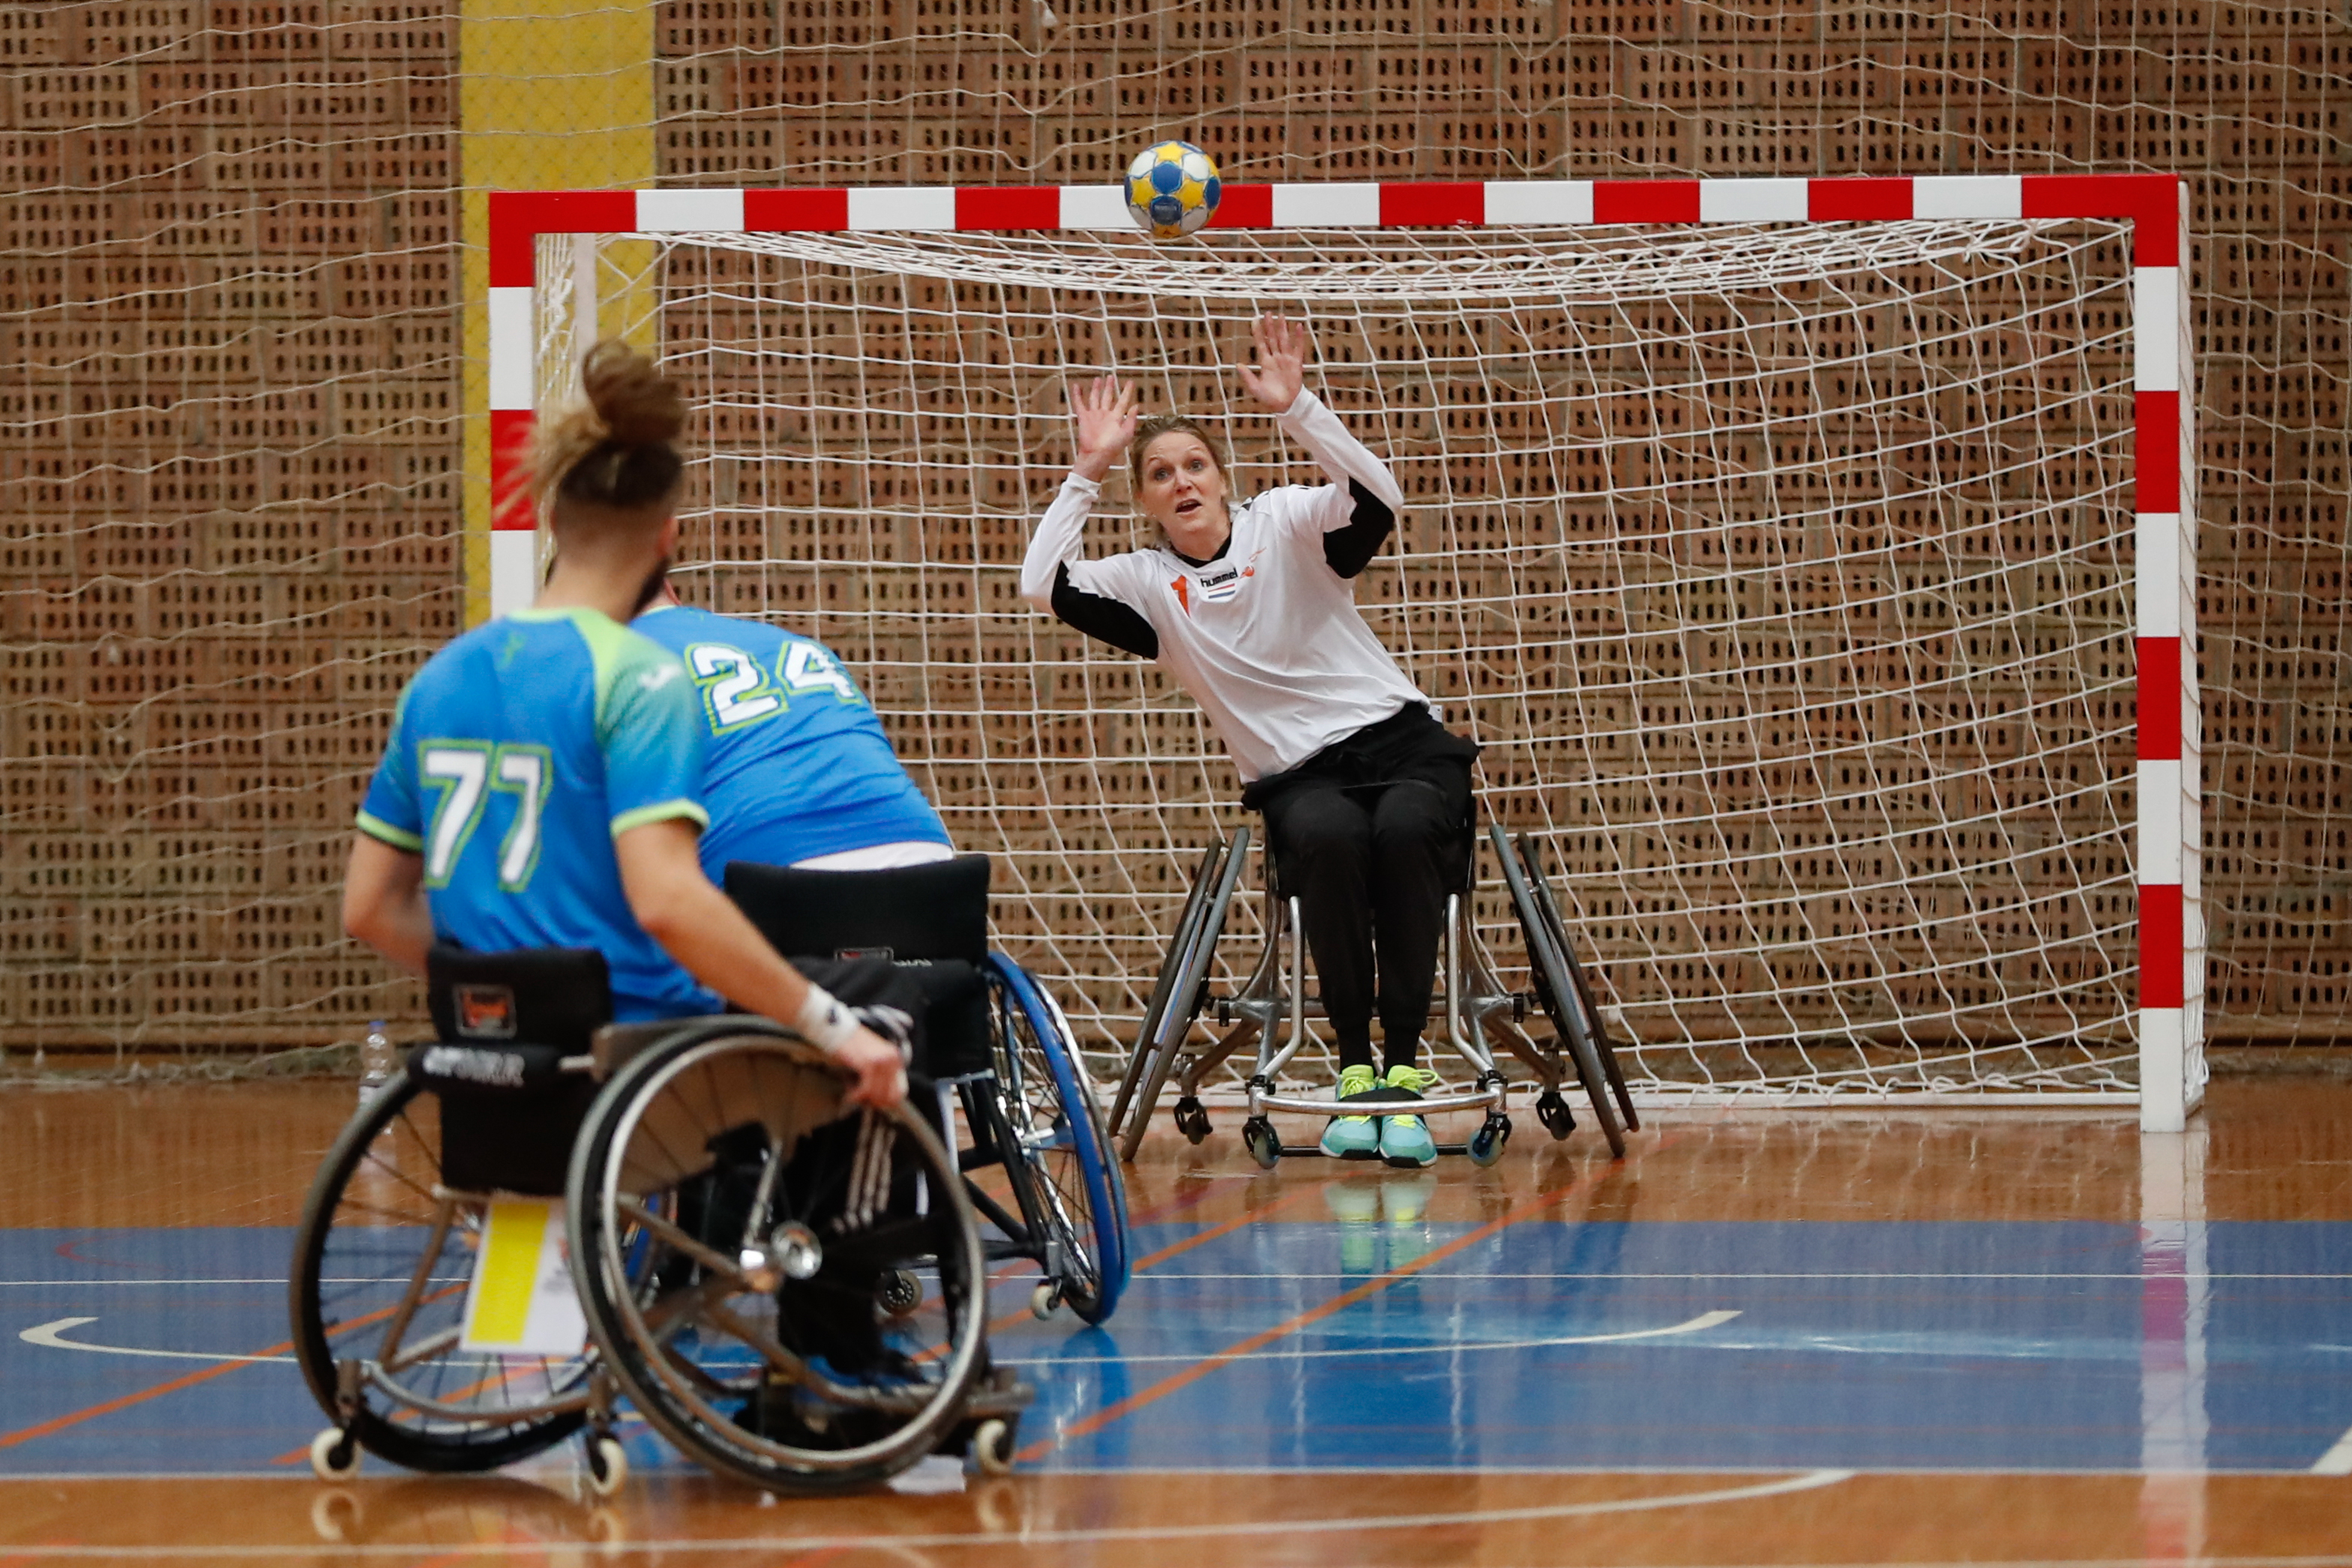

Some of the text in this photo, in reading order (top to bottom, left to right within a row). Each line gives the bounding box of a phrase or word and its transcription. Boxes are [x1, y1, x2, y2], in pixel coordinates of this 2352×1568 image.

[1200, 567, 1238, 587] hummel
[685, 639, 861, 734] 24
[418, 739, 551, 890] 77
